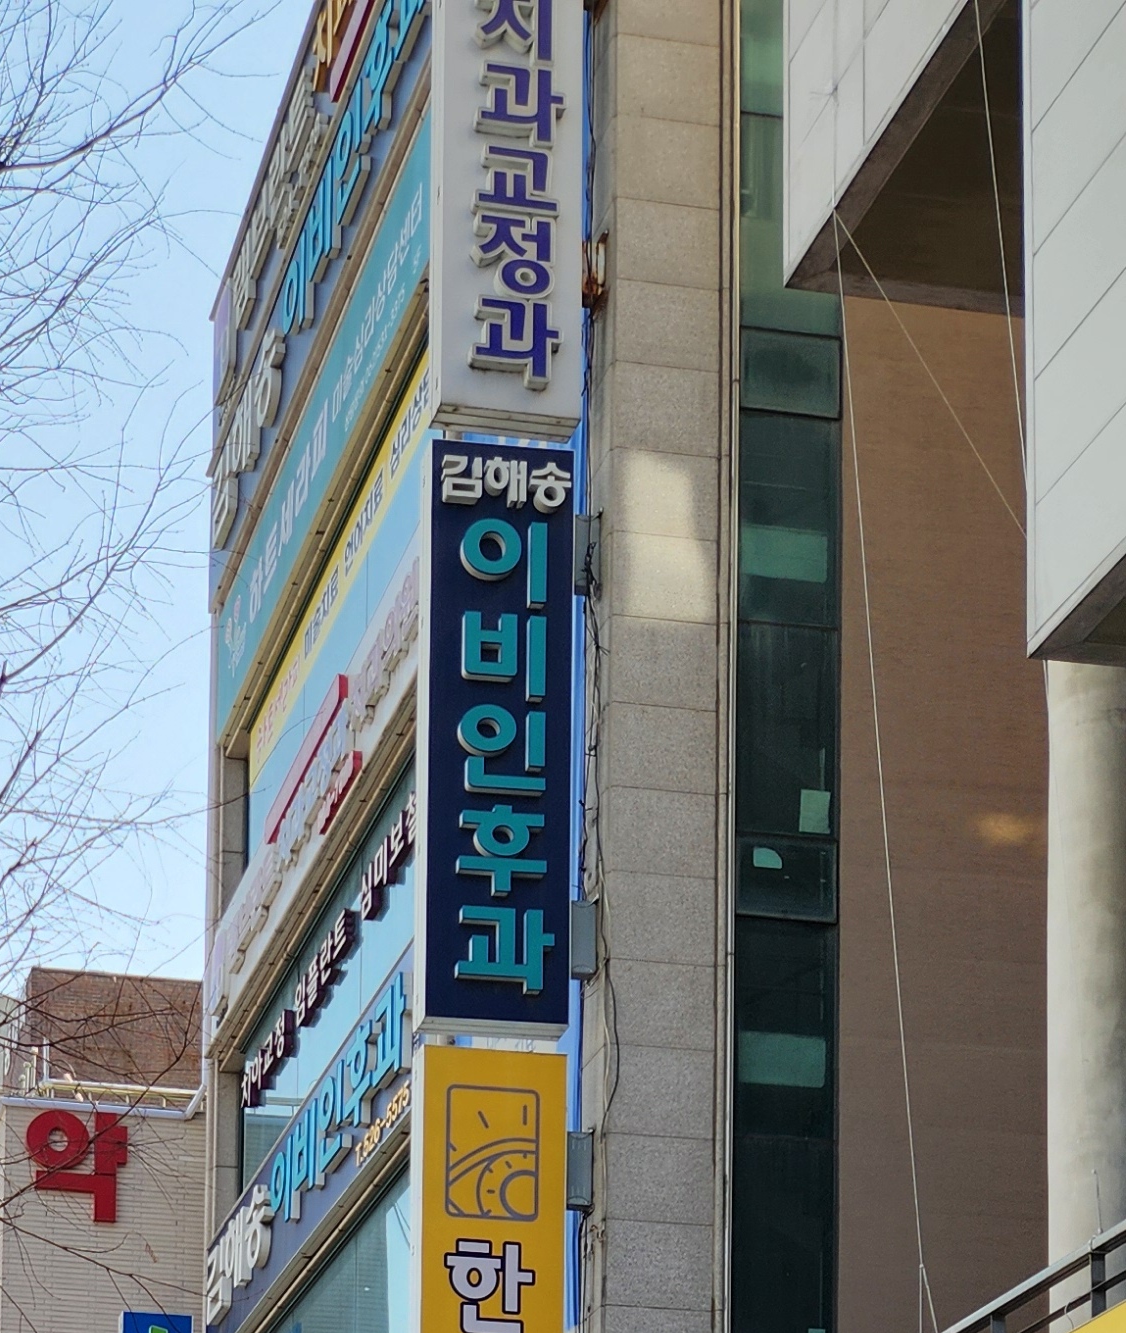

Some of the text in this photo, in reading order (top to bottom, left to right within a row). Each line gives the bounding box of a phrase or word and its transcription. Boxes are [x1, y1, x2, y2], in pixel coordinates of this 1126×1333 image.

[441, 454, 571, 514] 김해송
[454, 518, 555, 994] 이비인후과
[241, 1010, 286, 1108] 치아교정
[294, 908, 349, 1027] 임플란트
[26, 1109, 129, 1223] 약
[207, 971, 409, 1325] 김해송 이비인후과
